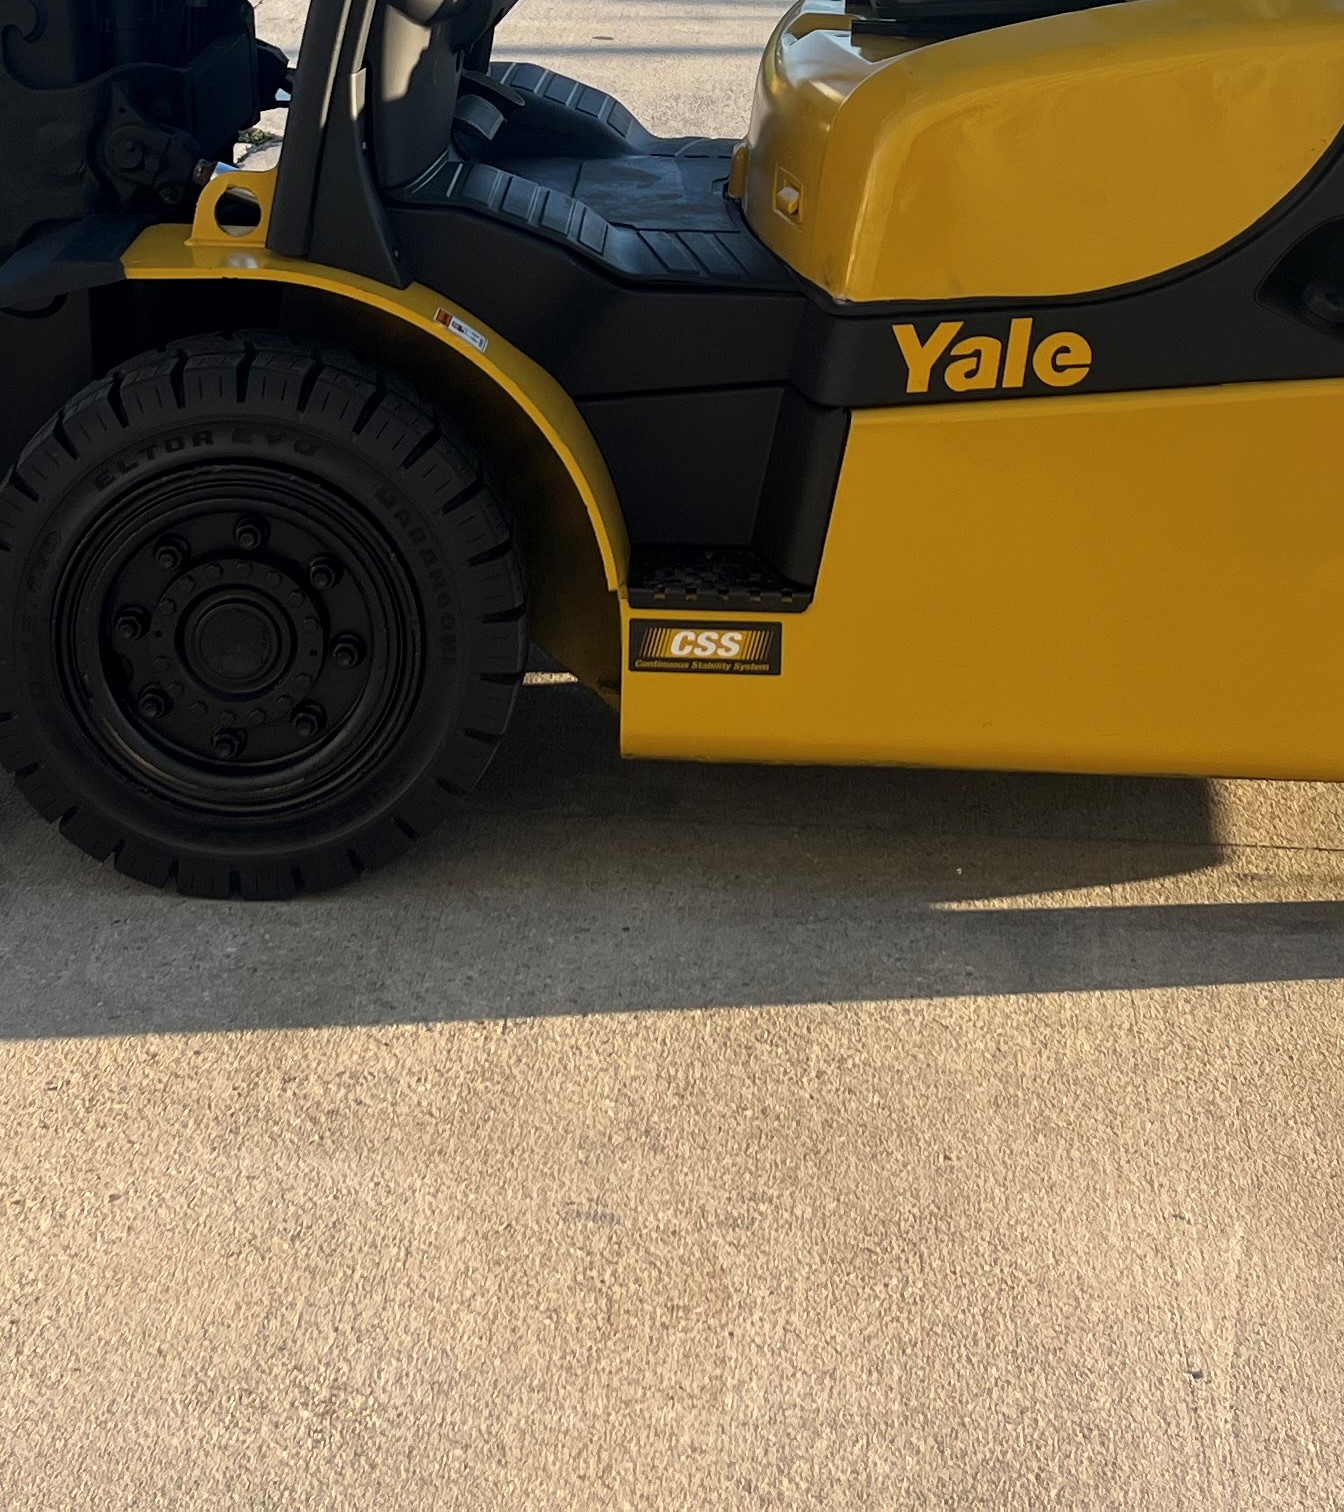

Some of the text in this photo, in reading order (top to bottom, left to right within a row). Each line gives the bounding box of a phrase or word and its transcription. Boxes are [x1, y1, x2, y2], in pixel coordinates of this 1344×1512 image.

[891, 316, 1093, 394] Yale
[670, 630, 743, 658] CSS
[634, 659, 770, 672] Continuous Stability System
